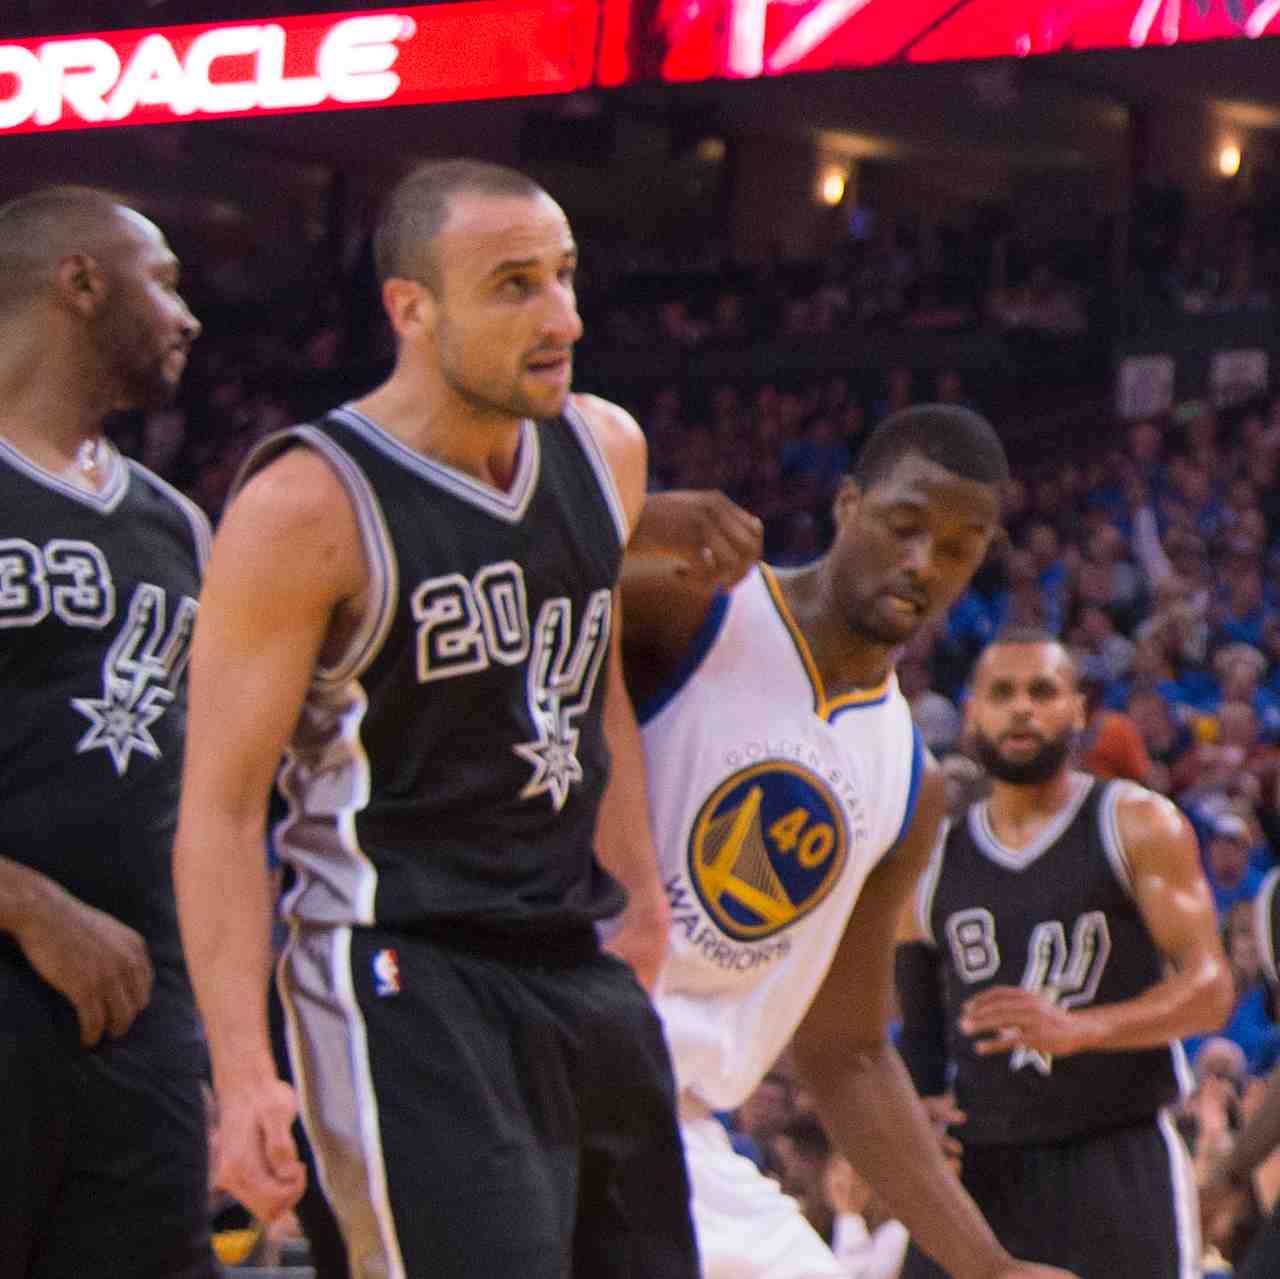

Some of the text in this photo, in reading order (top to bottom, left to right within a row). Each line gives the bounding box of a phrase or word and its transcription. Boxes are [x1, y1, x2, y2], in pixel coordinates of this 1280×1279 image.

[0, 536, 116, 629] 33
[410, 560, 530, 683] 20
[768, 806, 836, 869] 40
[944, 907, 1000, 984] 8
